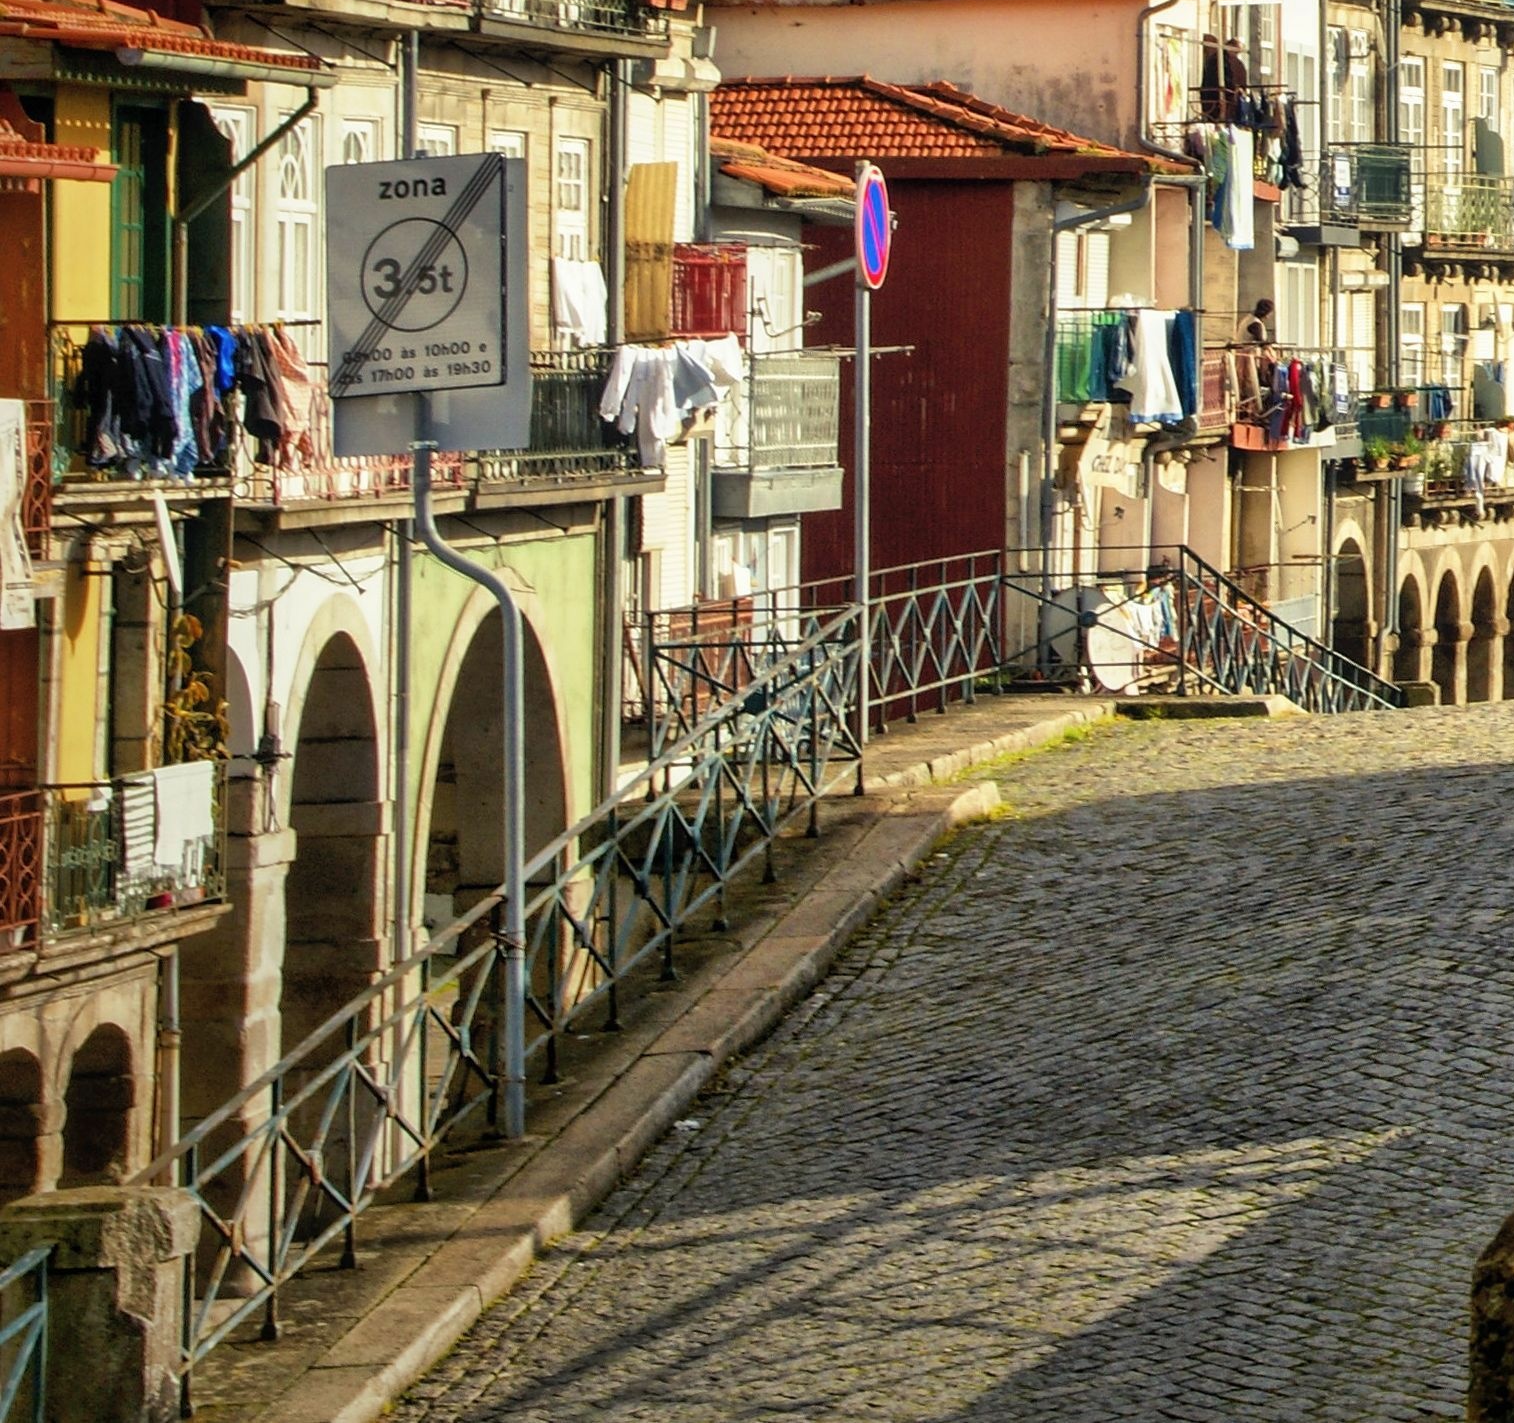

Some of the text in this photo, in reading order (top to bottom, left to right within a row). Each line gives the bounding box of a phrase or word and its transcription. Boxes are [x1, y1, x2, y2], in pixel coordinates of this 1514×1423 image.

[378, 176, 448, 201] zona
[400, 347, 417, 359] às
[424, 341, 472, 357] 10h00
[478, 343, 488, 353] e
[371, 367, 416, 383] 17h00
[423, 366, 439, 378] às
[446, 360, 492, 376] 19h30
